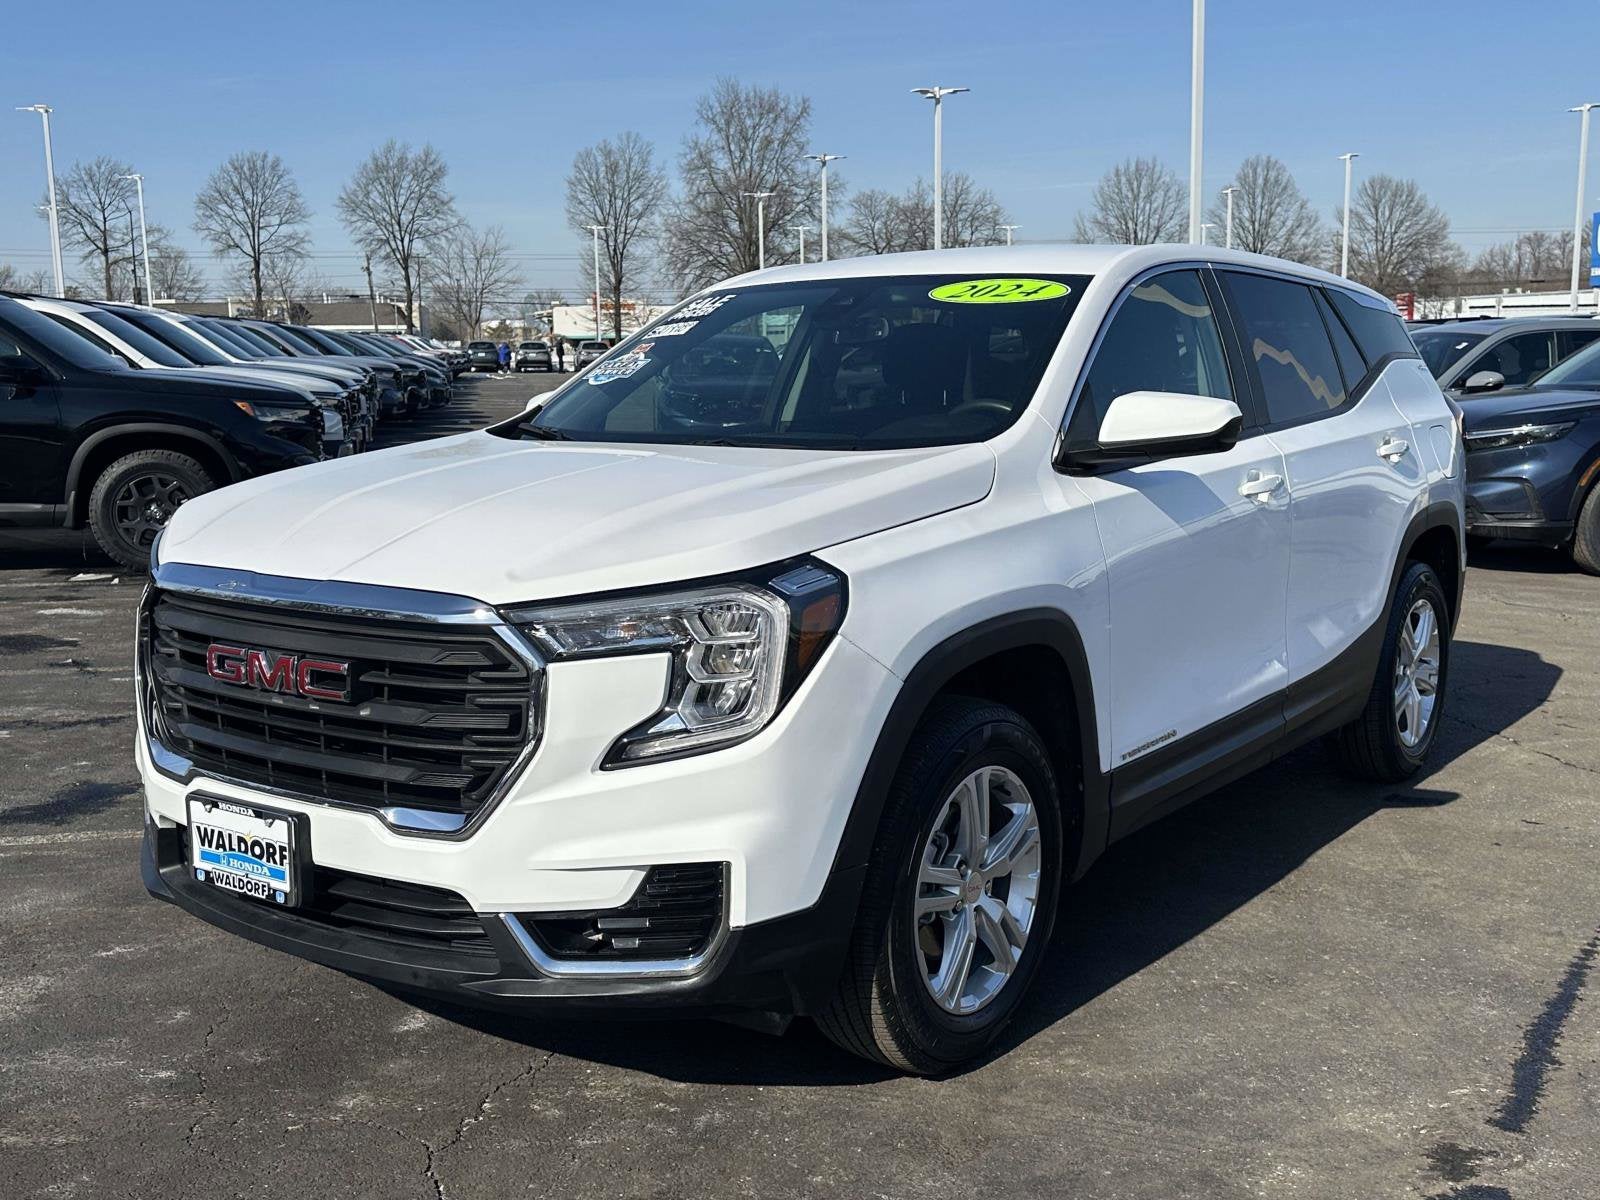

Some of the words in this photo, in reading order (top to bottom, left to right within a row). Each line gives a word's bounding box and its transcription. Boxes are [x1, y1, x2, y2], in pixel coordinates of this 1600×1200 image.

[945, 284, 1052, 298] 2024
[207, 644, 349, 701] GMC
[218, 802, 255, 817] HONDA
[196, 825, 287, 867] WALDORF
[229, 858, 271, 876] HONDA
[213, 871, 267, 897] WALDORF
